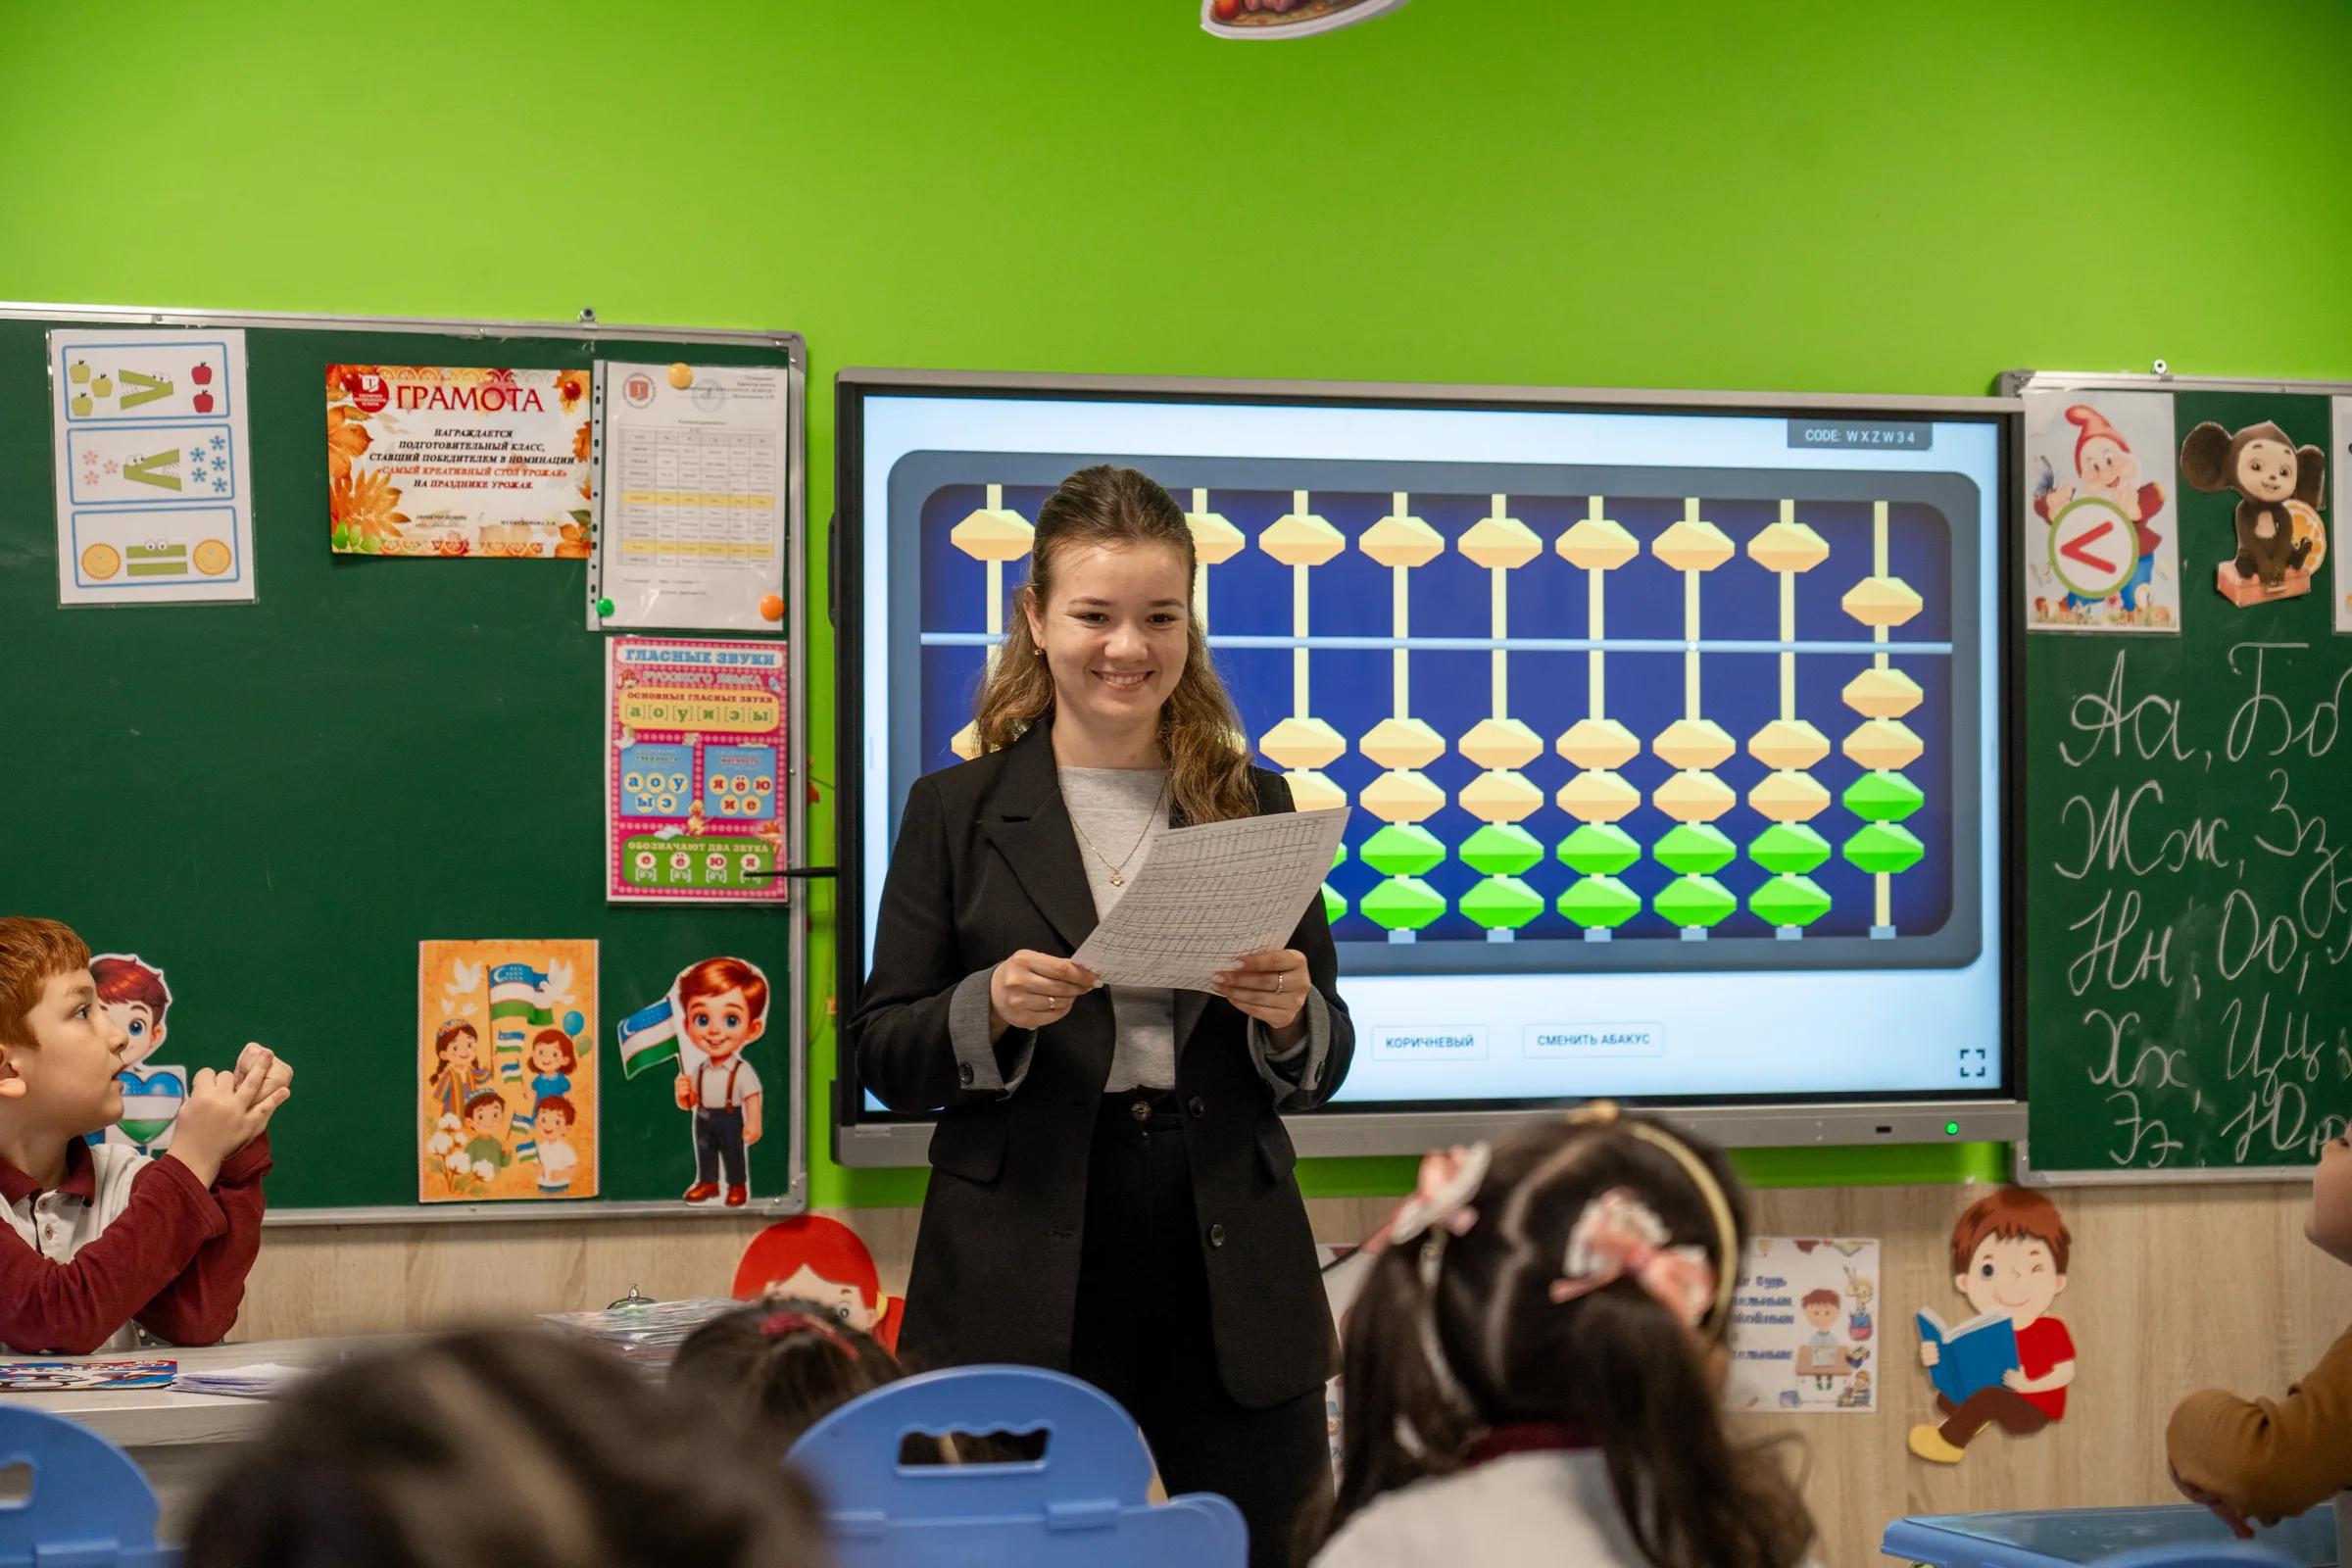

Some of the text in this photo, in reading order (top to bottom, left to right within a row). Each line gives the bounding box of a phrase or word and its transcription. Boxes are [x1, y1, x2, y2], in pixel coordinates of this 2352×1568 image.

[396, 385, 545, 412] ГРАМОТА
[434, 429, 514, 439] НАГРАЖДАЕТСЯ
[1805, 429, 1840, 442] CODE:
[399, 441, 545, 452] ПОДГОТОВИТЕЛЬНЫЙ КЛАСС,
[369, 452, 419, 463] СТАВШИЙ
[421, 454, 497, 465] ПОБЕДИТЕЛЕМ
[509, 455, 575, 466] НОМИНАЦИИ
[422, 466, 491, 476] КРЕАТИВНЫЙ
[415, 479, 428, 488] НА
[430, 479, 489, 489] ПРАЗДНИКЕ
[625, 649, 776, 665] ГЛАСНЫЕ ЗВУКИ
[627, 692, 773, 704] ОСНОВНЫЕ ГЛАСНЫЕ ЗВУКИ
[2060, 649, 2212, 772] Аа,
[627, 842, 769, 853] ОБОЗНАЧАЮТ ДВА ЗВУКА
[1386, 1035, 1474, 1049] КОРИЧНЕВЫЙ
[1537, 1033, 1650, 1047] СМЕНИТЬ АБАКУС
